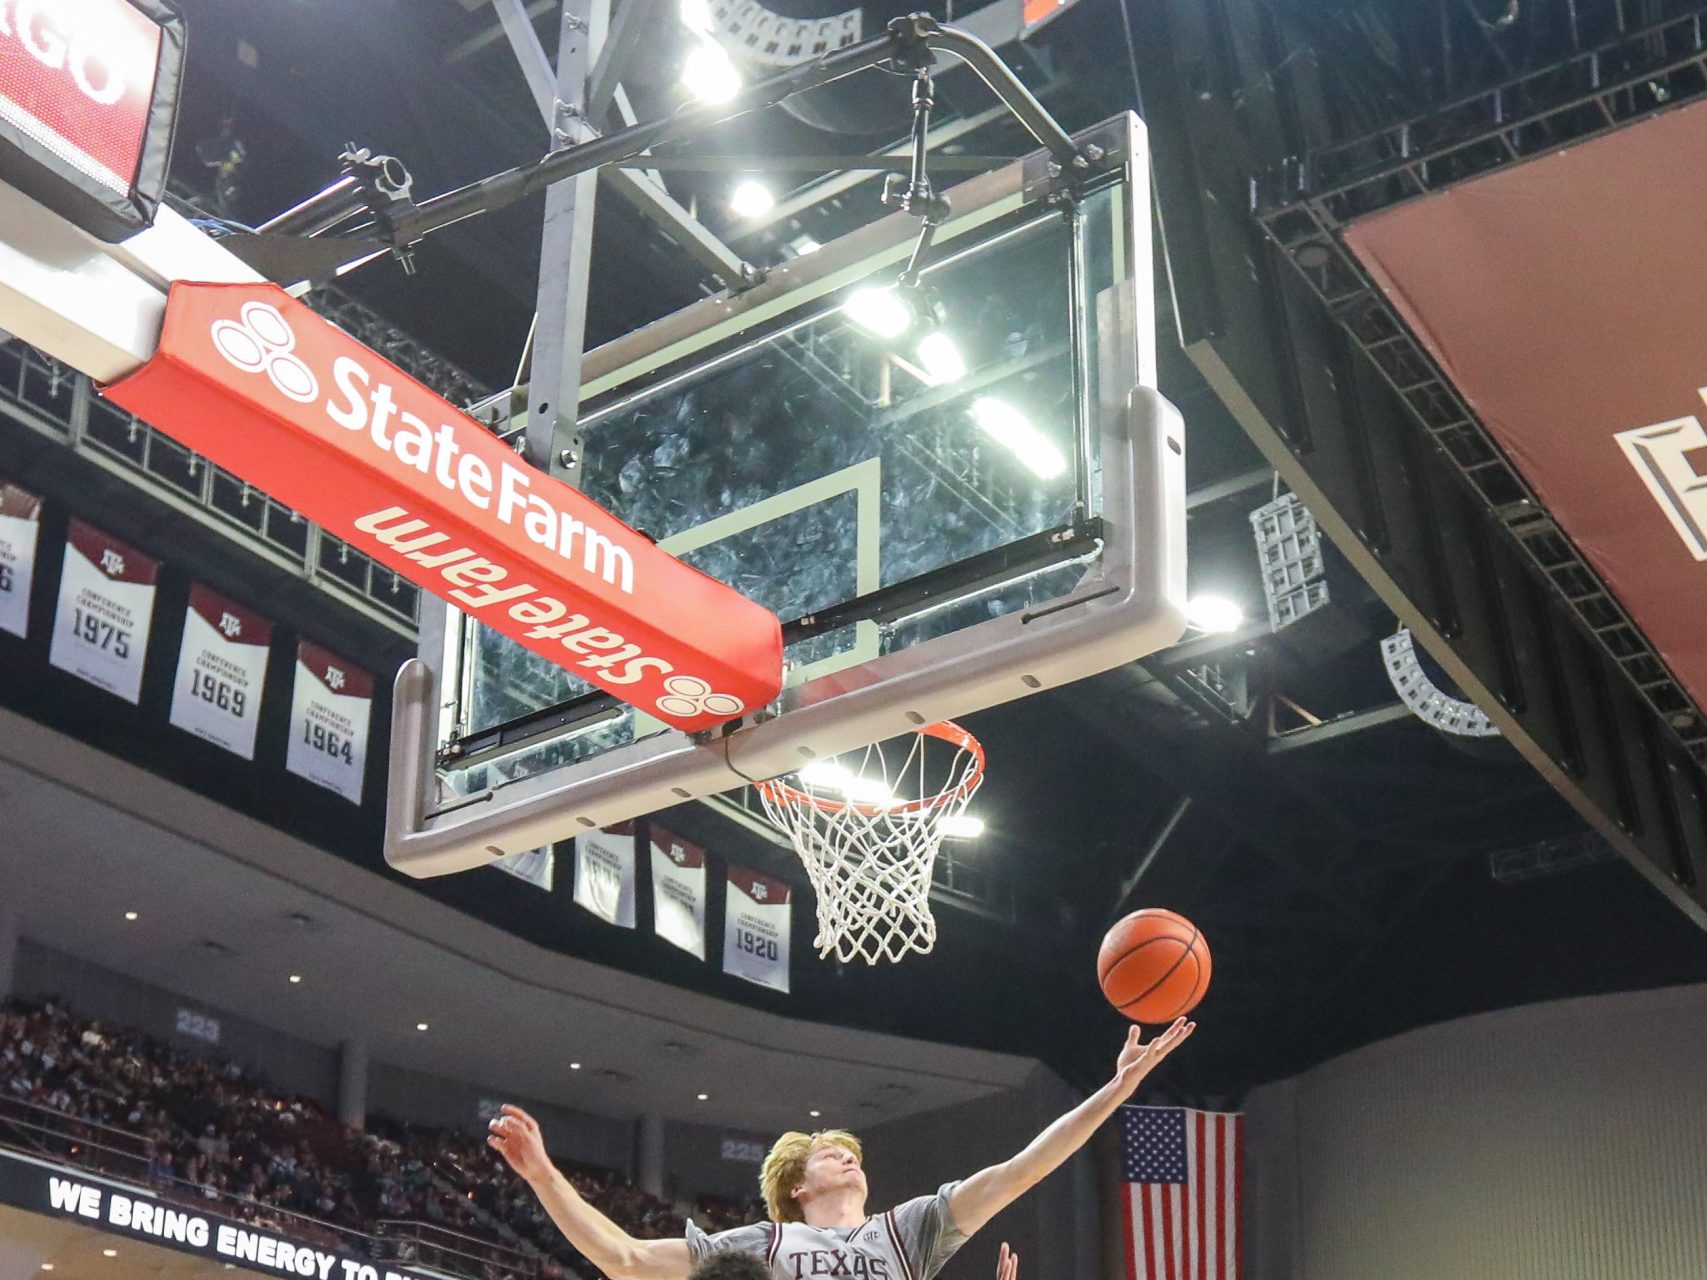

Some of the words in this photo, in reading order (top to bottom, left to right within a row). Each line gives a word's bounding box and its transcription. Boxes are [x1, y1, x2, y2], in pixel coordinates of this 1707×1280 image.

[73, 607, 131, 659] 1975
[191, 668, 246, 718] 1969
[304, 718, 353, 766] 1964
[736, 928, 778, 962] 1920
[49, 1177, 101, 1220] WE
[108, 1194, 209, 1247] BRING
[216, 1224, 336, 1280] ENERGY
